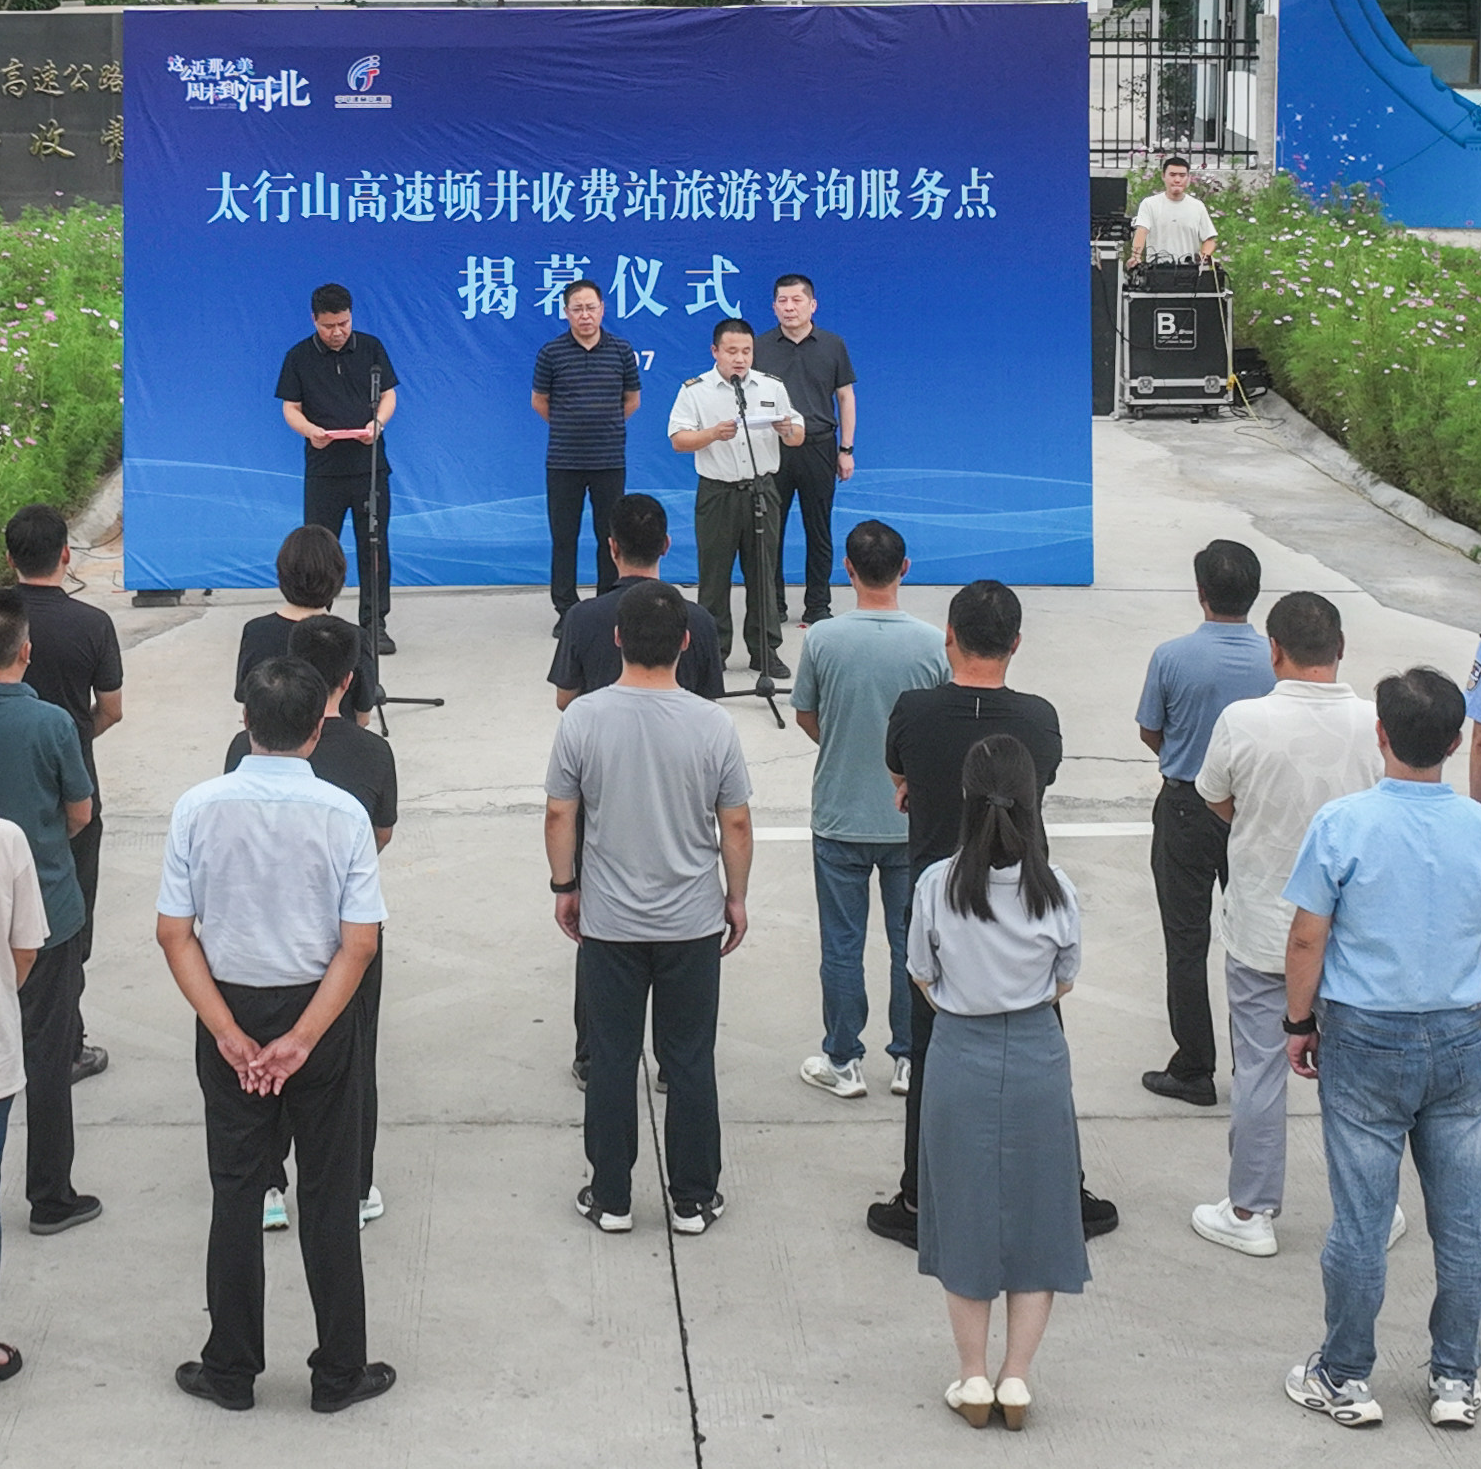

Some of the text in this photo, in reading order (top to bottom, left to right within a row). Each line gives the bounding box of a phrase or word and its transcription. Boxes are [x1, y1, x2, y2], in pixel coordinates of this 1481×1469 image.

[206, 168, 997, 223] 太行山高速顿井收费站旅游咨询服务点
